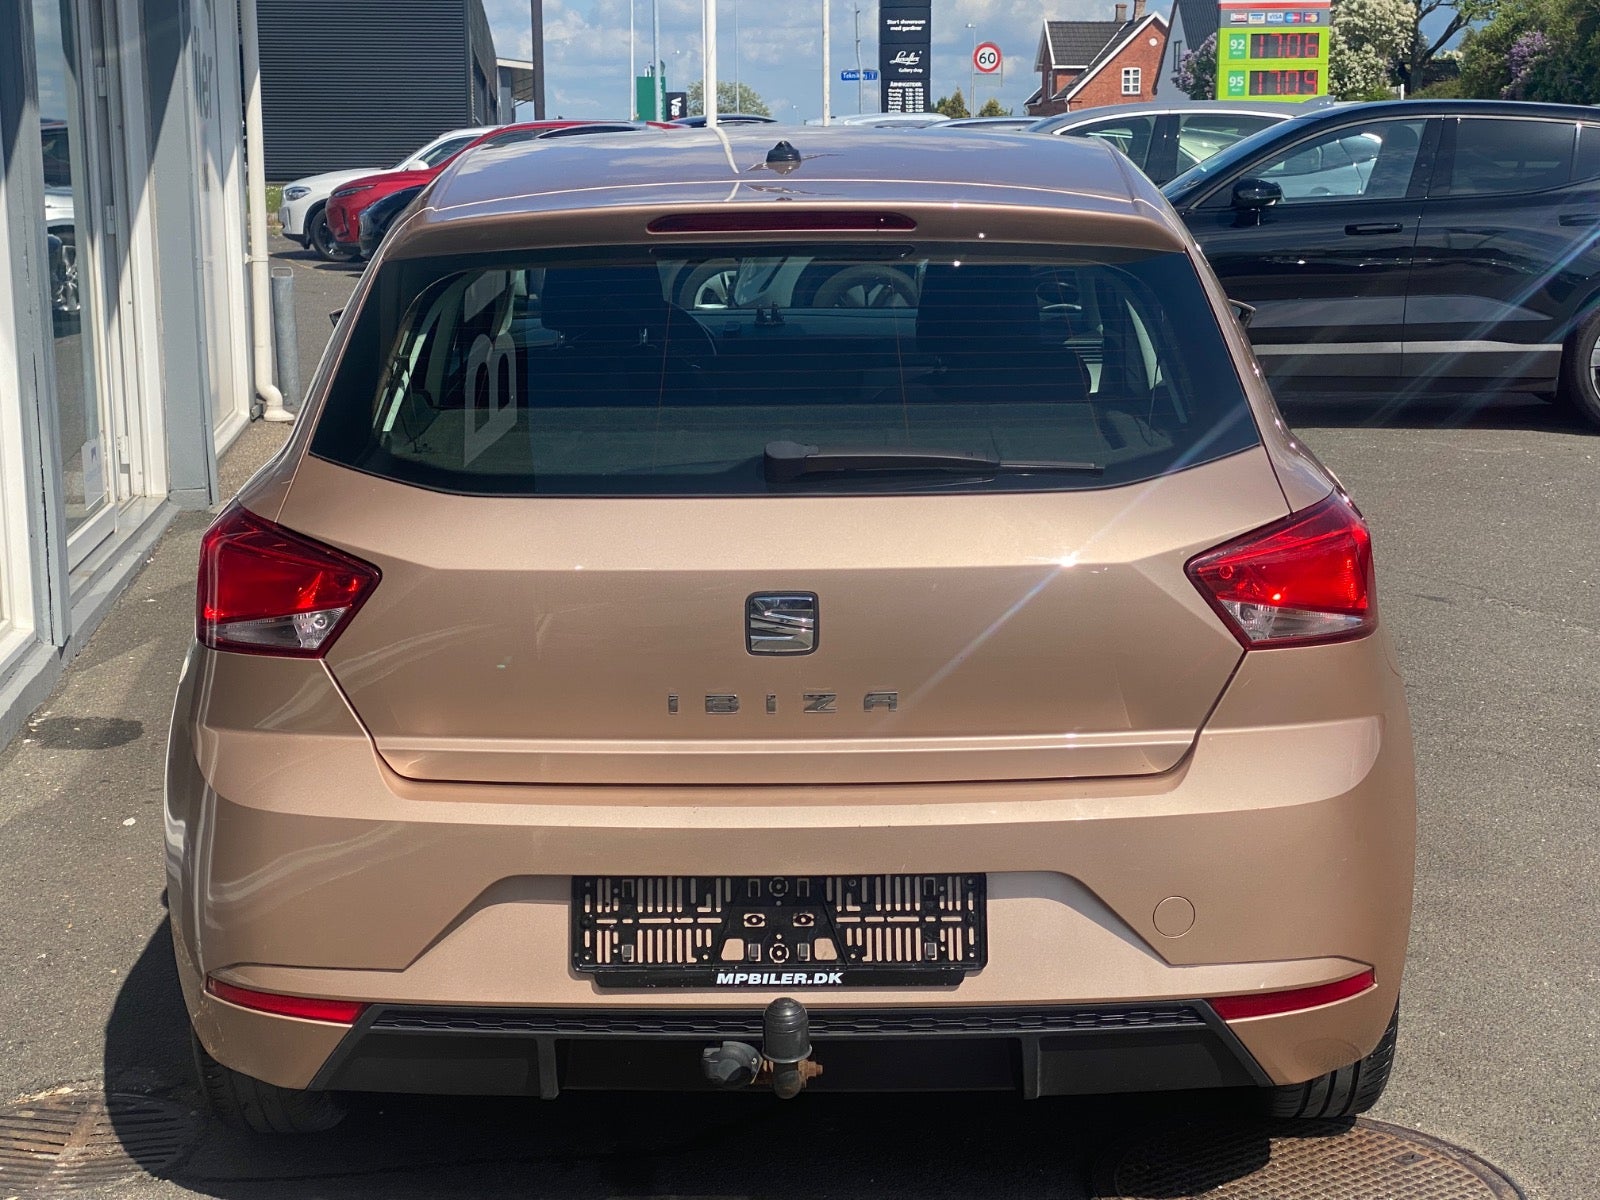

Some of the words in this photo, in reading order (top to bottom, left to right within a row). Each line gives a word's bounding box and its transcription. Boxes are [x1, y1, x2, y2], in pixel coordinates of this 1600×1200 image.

[1230, 39, 1245, 50] 92
[978, 52, 996, 65] 60
[1229, 76, 1244, 87] 95
[667, 691, 898, 714] IBIZA
[716, 972, 843, 985] MPBILER.DK
